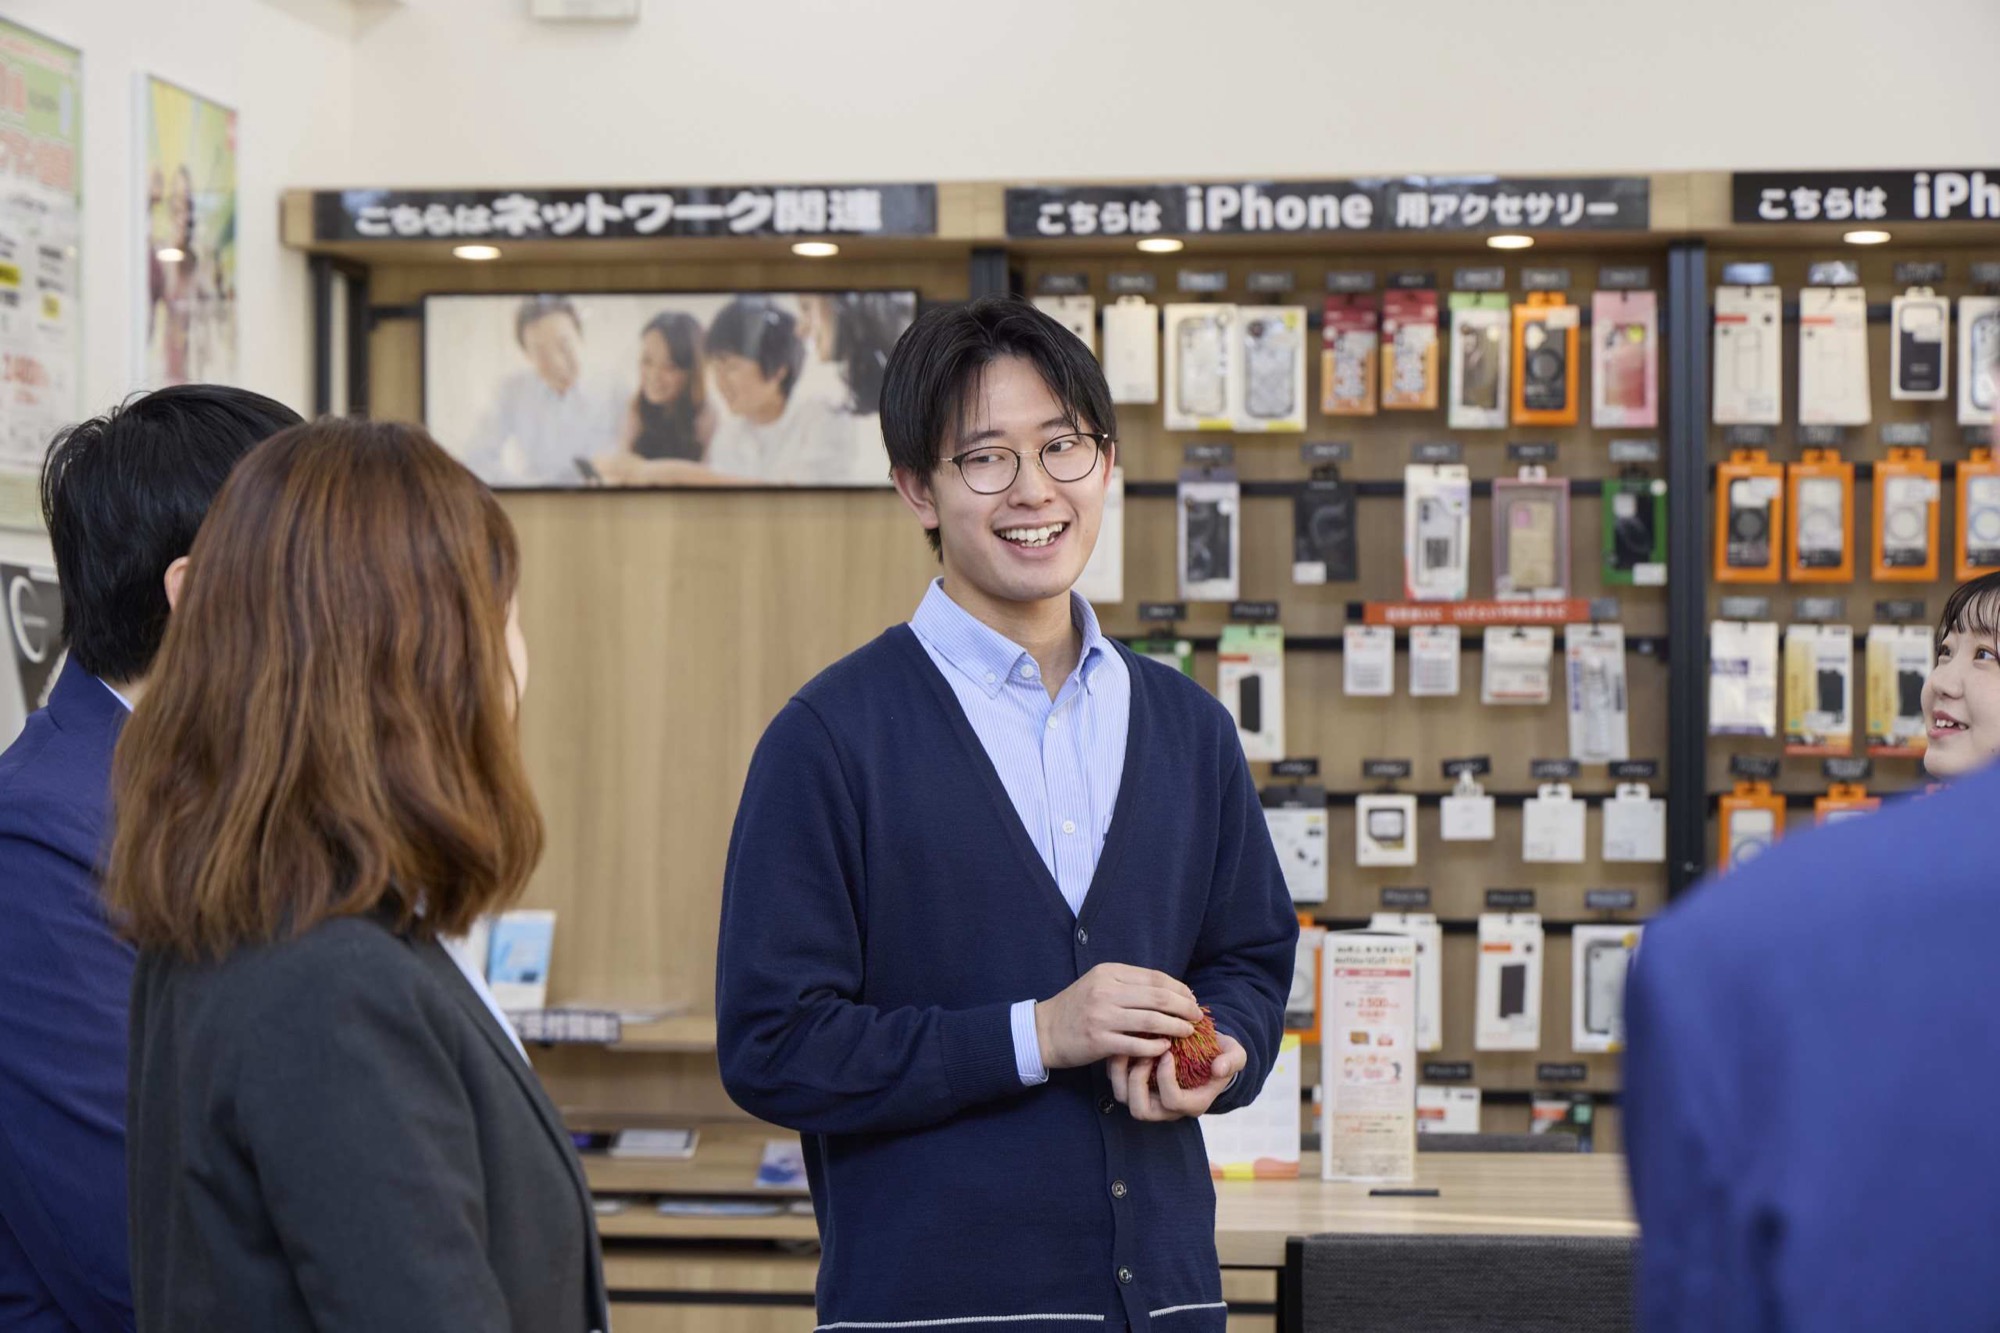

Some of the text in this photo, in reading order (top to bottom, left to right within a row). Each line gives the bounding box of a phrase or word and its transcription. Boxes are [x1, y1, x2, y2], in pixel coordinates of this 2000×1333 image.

[355, 190, 882, 236] こちらはネットワーク関連
[1036, 186, 1618, 235] こちらは iPhone 用アクセサリー
[1758, 186, 1887, 220] こちらは
